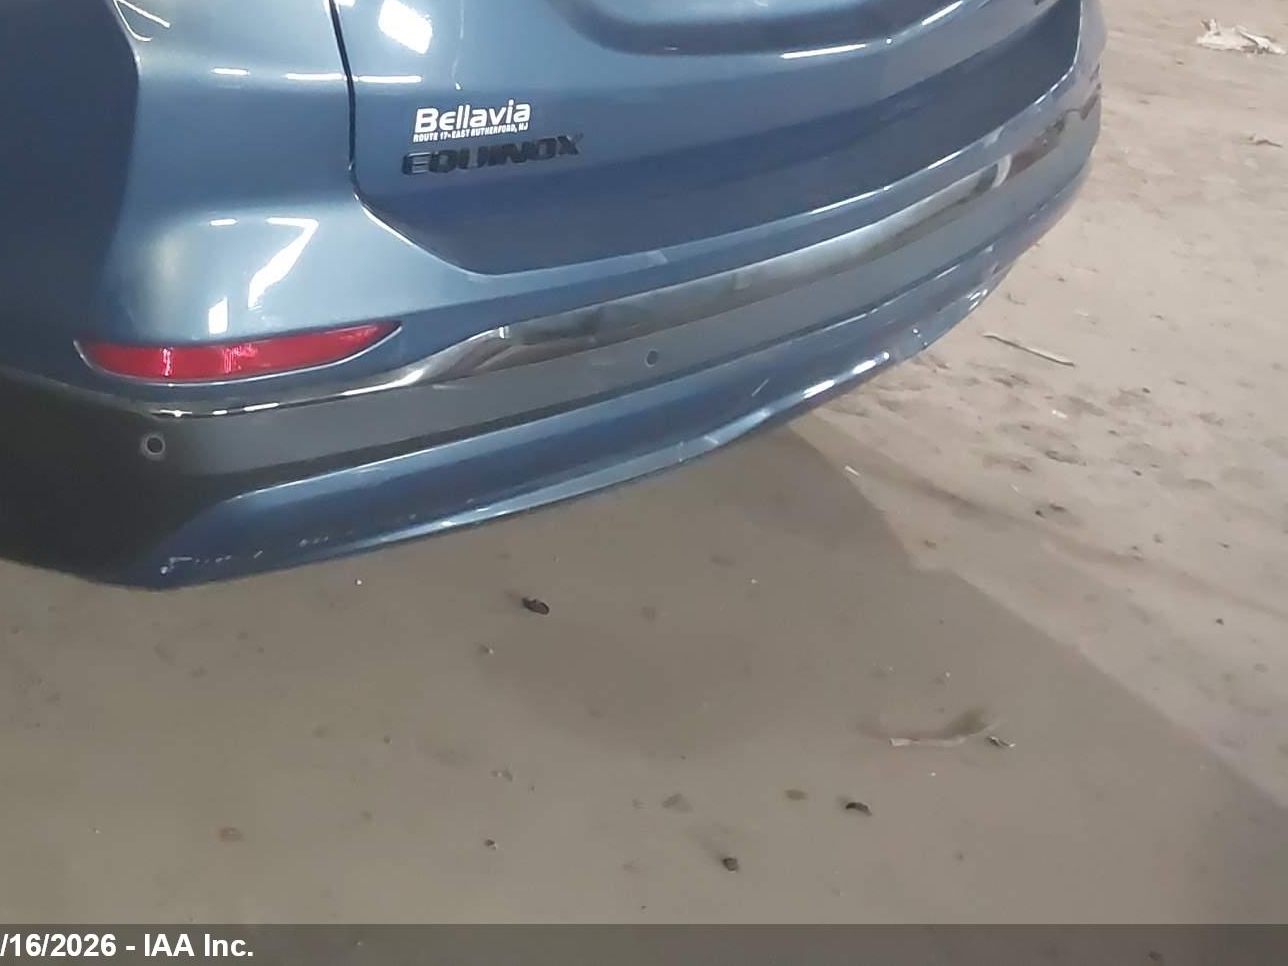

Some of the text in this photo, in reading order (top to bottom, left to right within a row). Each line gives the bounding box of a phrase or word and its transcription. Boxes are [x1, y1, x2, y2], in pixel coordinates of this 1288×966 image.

[413, 132, 439, 143] ROUTE
[518, 121, 530, 132] NJ
[414, 99, 531, 134] Bellavia
[402, 135, 583, 175] EQUINOX
